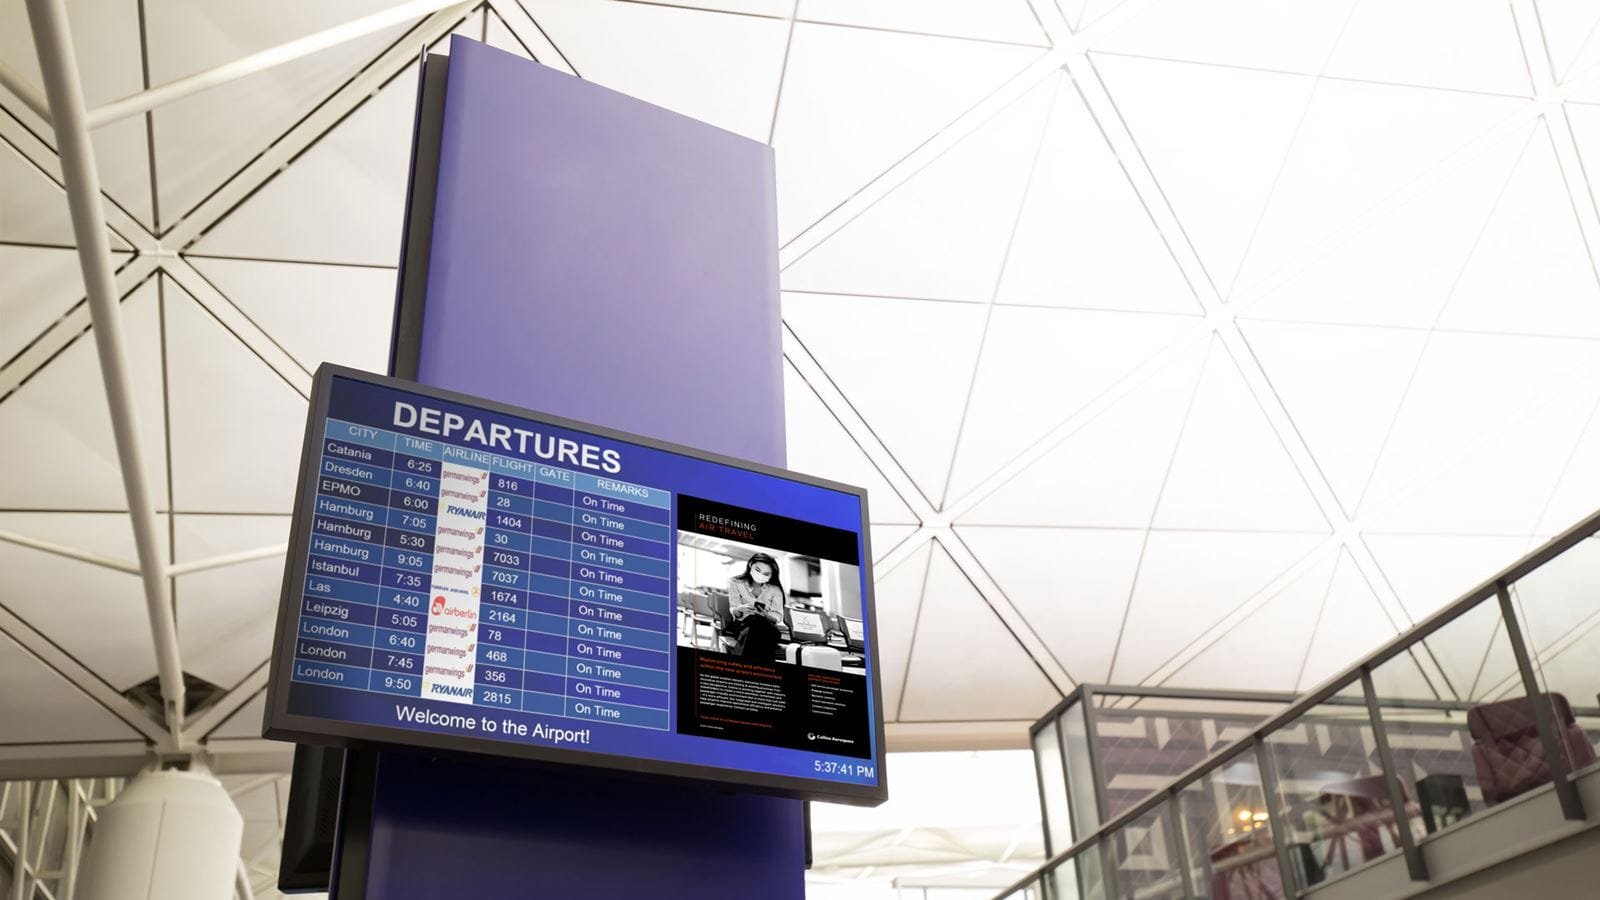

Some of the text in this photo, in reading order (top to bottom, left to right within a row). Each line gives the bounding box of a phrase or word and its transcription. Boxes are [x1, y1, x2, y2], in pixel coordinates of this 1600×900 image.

[349, 426, 649, 498] CITY TIME AIRLINE FLIGHT GATE REMARKS
[393, 401, 621, 473] DEPARTURES
[325, 462, 372, 480] Dresden
[406, 478, 430, 492] 6:40
[496, 496, 510, 507] 28
[582, 514, 597, 525] On
[601, 518, 624, 530] Time
[328, 442, 372, 460] Catania
[408, 459, 432, 472] 6:25
[498, 479, 518, 490] 816
[583, 496, 598, 506] On
[601, 500, 625, 512] Time
[320, 500, 374, 520] Hamburg
[402, 516, 426, 528] 7:05
[494, 534, 508, 544] 30
[581, 550, 596, 560] On
[600, 553, 624, 566] Time
[322, 480, 624, 548] EPMO 6:00 RYANAIR 1404 On Time
[699, 513, 756, 532] REDEFINING
[699, 522, 754, 540] AIR TRAVEL
[314, 539, 369, 560] Hamburg
[398, 554, 422, 568] 9:05
[492, 572, 518, 584] 7037
[580, 586, 594, 597] On
[598, 590, 623, 602] Time
[317, 520, 372, 540] Hamburg
[400, 534, 425, 548] 5:30
[493, 553, 520, 566] 7033
[580, 568, 595, 578] On
[599, 571, 623, 584] Time
[309, 580, 622, 640] Las 4:40 airberlin 2164 On Time
[312, 559, 359, 576] Istanbul
[396, 574, 421, 587] 7:35
[492, 591, 517, 604] 1674
[578, 606, 594, 616] On
[598, 608, 622, 622] Time
[304, 622, 348, 638] London
[389, 634, 416, 648] 6:40
[486, 650, 508, 662] 468
[576, 663, 592, 674] On
[596, 666, 621, 679] Time
[306, 600, 348, 619] Leipzig
[392, 614, 417, 628] 5:05
[488, 630, 502, 640] 78
[577, 644, 592, 654] On
[596, 646, 622, 659] Time
[298, 665, 620, 718] London 9:50 RYANAIR 2815 On Time
[301, 643, 346, 660] London
[388, 656, 414, 669] 7:45
[485, 670, 506, 682] 356
[576, 682, 592, 694] On
[595, 686, 620, 698] Time
[396, 705, 590, 744] Welcome to the Airport!
[815, 760, 874, 778] 5:37:41 PM
